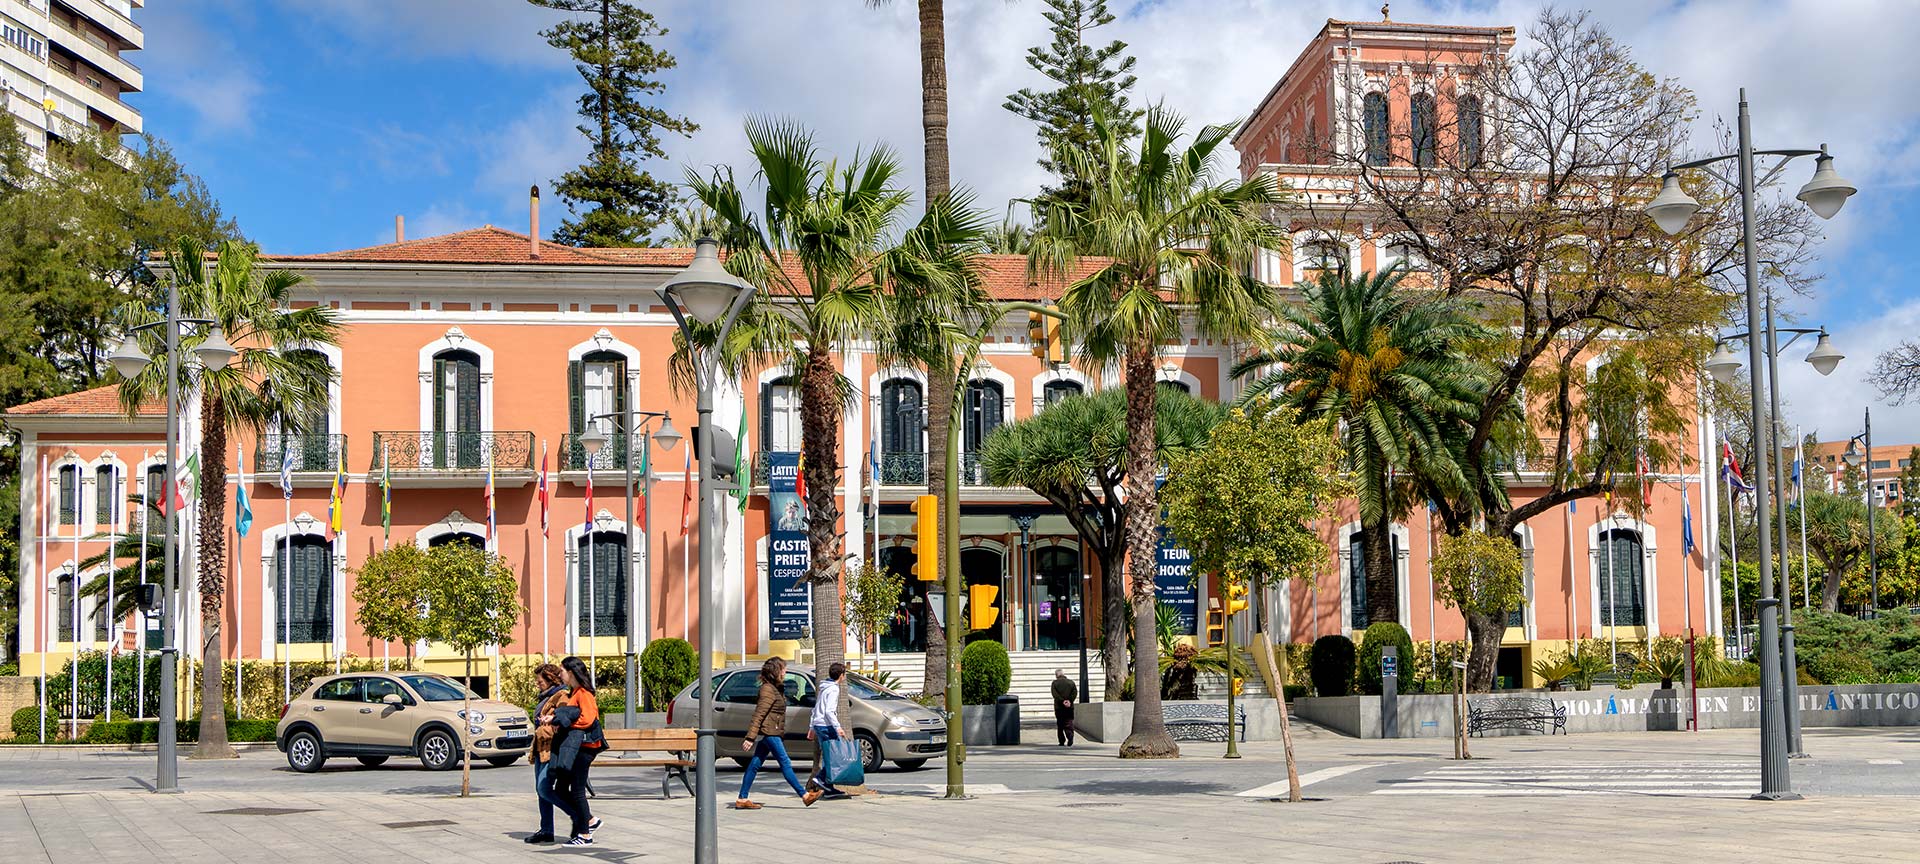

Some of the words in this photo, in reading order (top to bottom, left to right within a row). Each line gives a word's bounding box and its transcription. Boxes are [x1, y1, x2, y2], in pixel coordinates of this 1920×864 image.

[771, 465, 798, 476] LATITU
[773, 540, 807, 551] CASTR
[775, 554, 807, 566] PRIET
[1163, 548, 1190, 560] TEUN
[773, 568, 807, 578] CESPEDO
[1160, 564, 1193, 576] HOCKS
[1700, 696, 1729, 713] EN
[1742, 696, 1761, 712] E
[1798, 689, 1920, 712] TLÁNTICO
